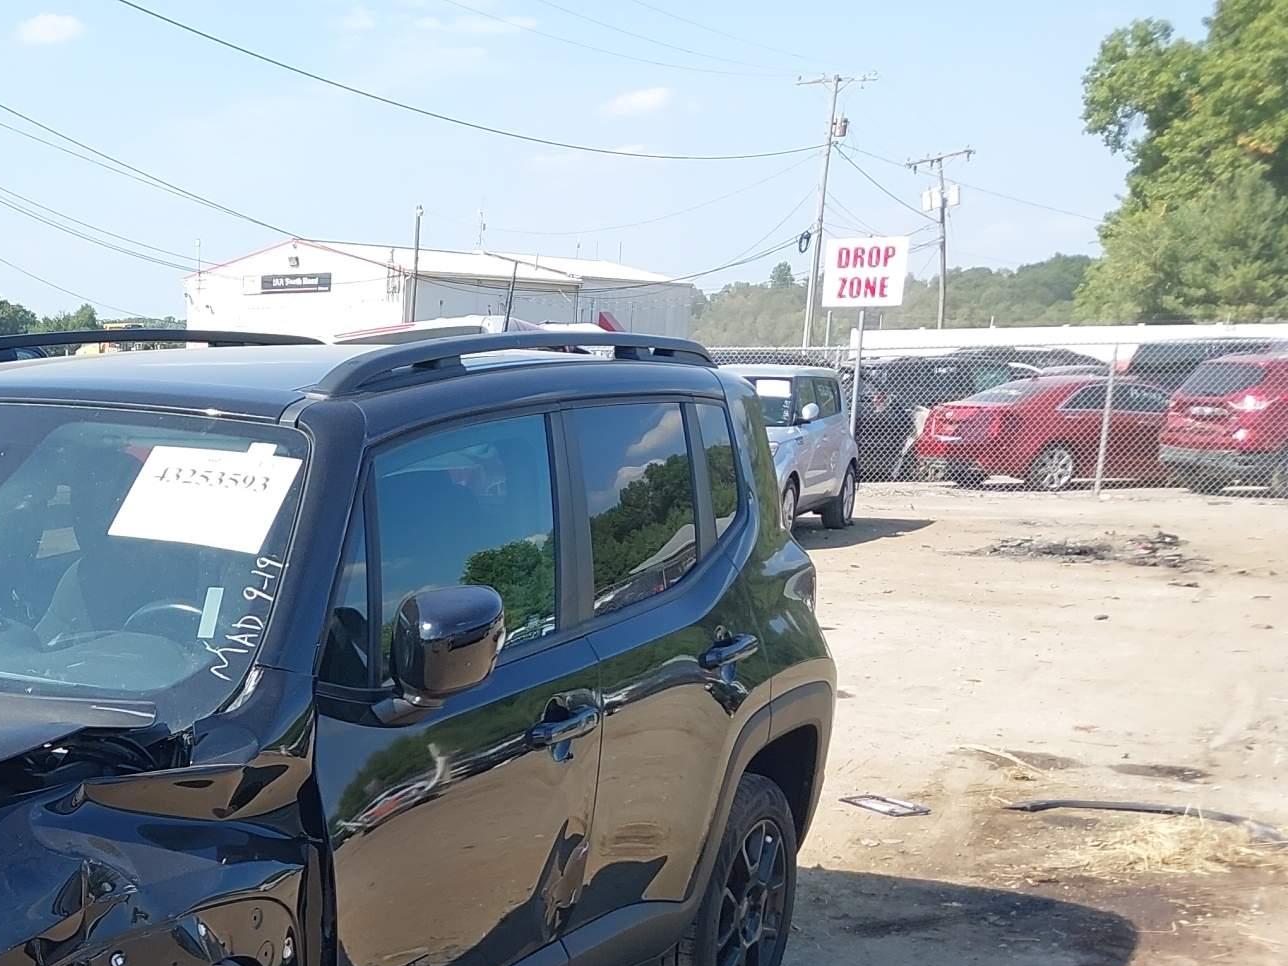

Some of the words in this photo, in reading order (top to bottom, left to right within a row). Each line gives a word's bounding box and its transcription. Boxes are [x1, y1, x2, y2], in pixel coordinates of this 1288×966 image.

[837, 246, 896, 269] DROP
[837, 276, 889, 298] ZONE
[154, 467, 270, 491] 43253593
